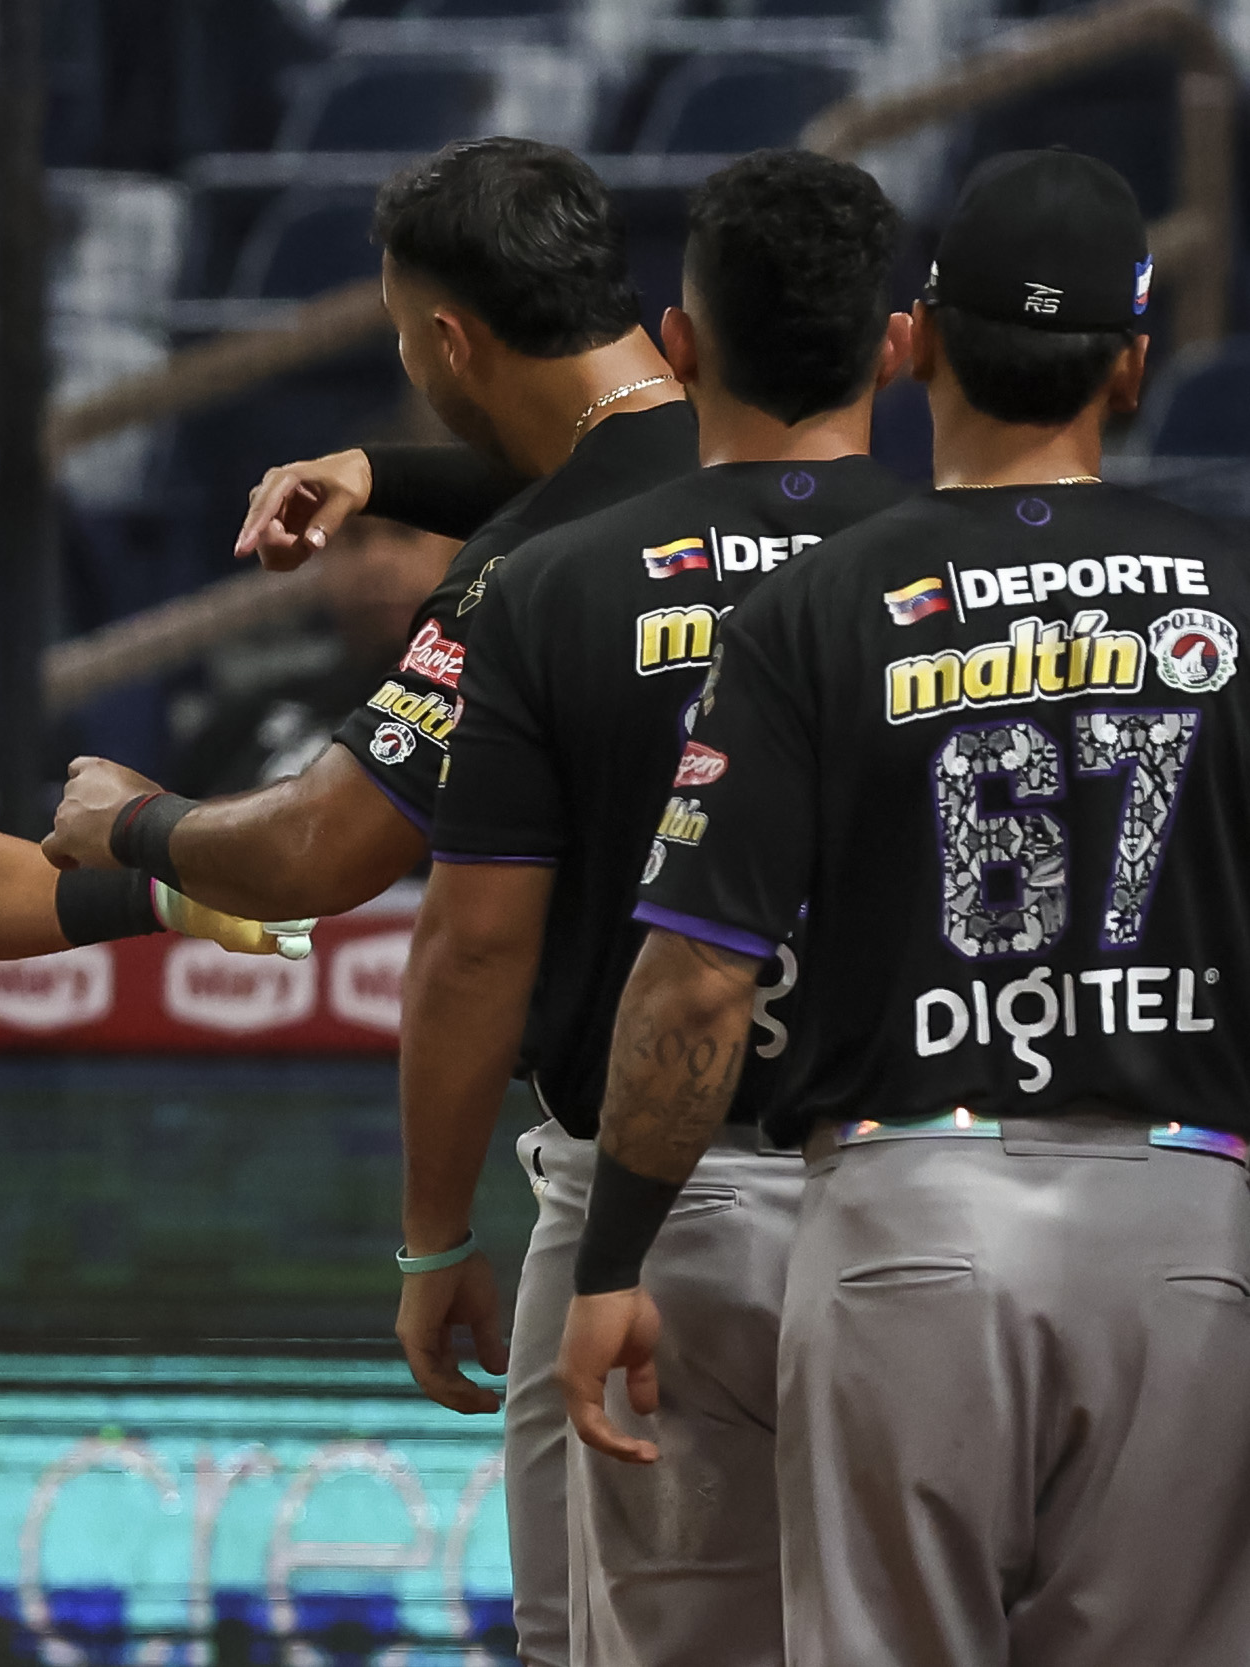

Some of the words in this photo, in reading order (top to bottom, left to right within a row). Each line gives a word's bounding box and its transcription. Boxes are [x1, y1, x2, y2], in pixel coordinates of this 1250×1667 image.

[963, 554, 1210, 609] DEPORTE
[888, 612, 1146, 723] maltín
[1152, 612, 1235, 654] POLAR
[931, 707, 1200, 960] 67
